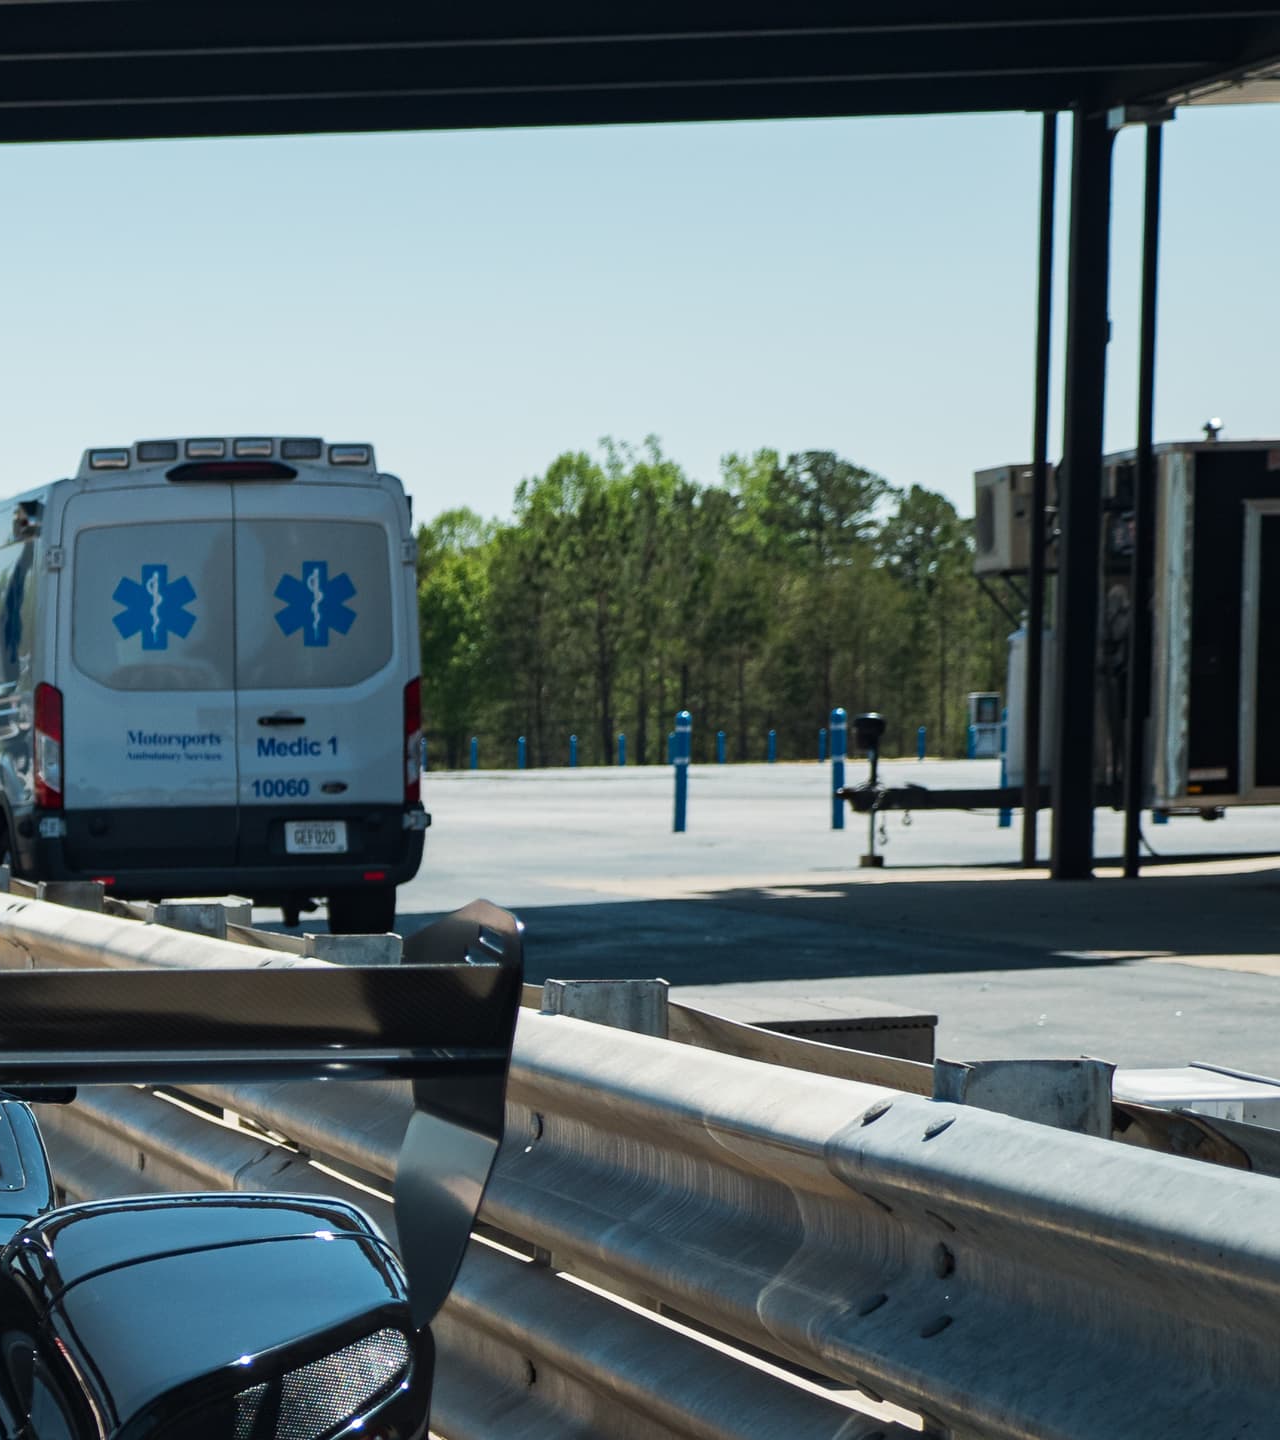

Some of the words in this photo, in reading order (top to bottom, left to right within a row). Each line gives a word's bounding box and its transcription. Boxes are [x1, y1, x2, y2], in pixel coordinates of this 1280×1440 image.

[127, 731, 222, 748] Motorsports
[257, 737, 321, 758] Medic
[327, 737, 338, 756] 1
[126, 752, 181, 762] Ambulatory
[184, 752, 222, 761] Services
[251, 778, 310, 798] 10060
